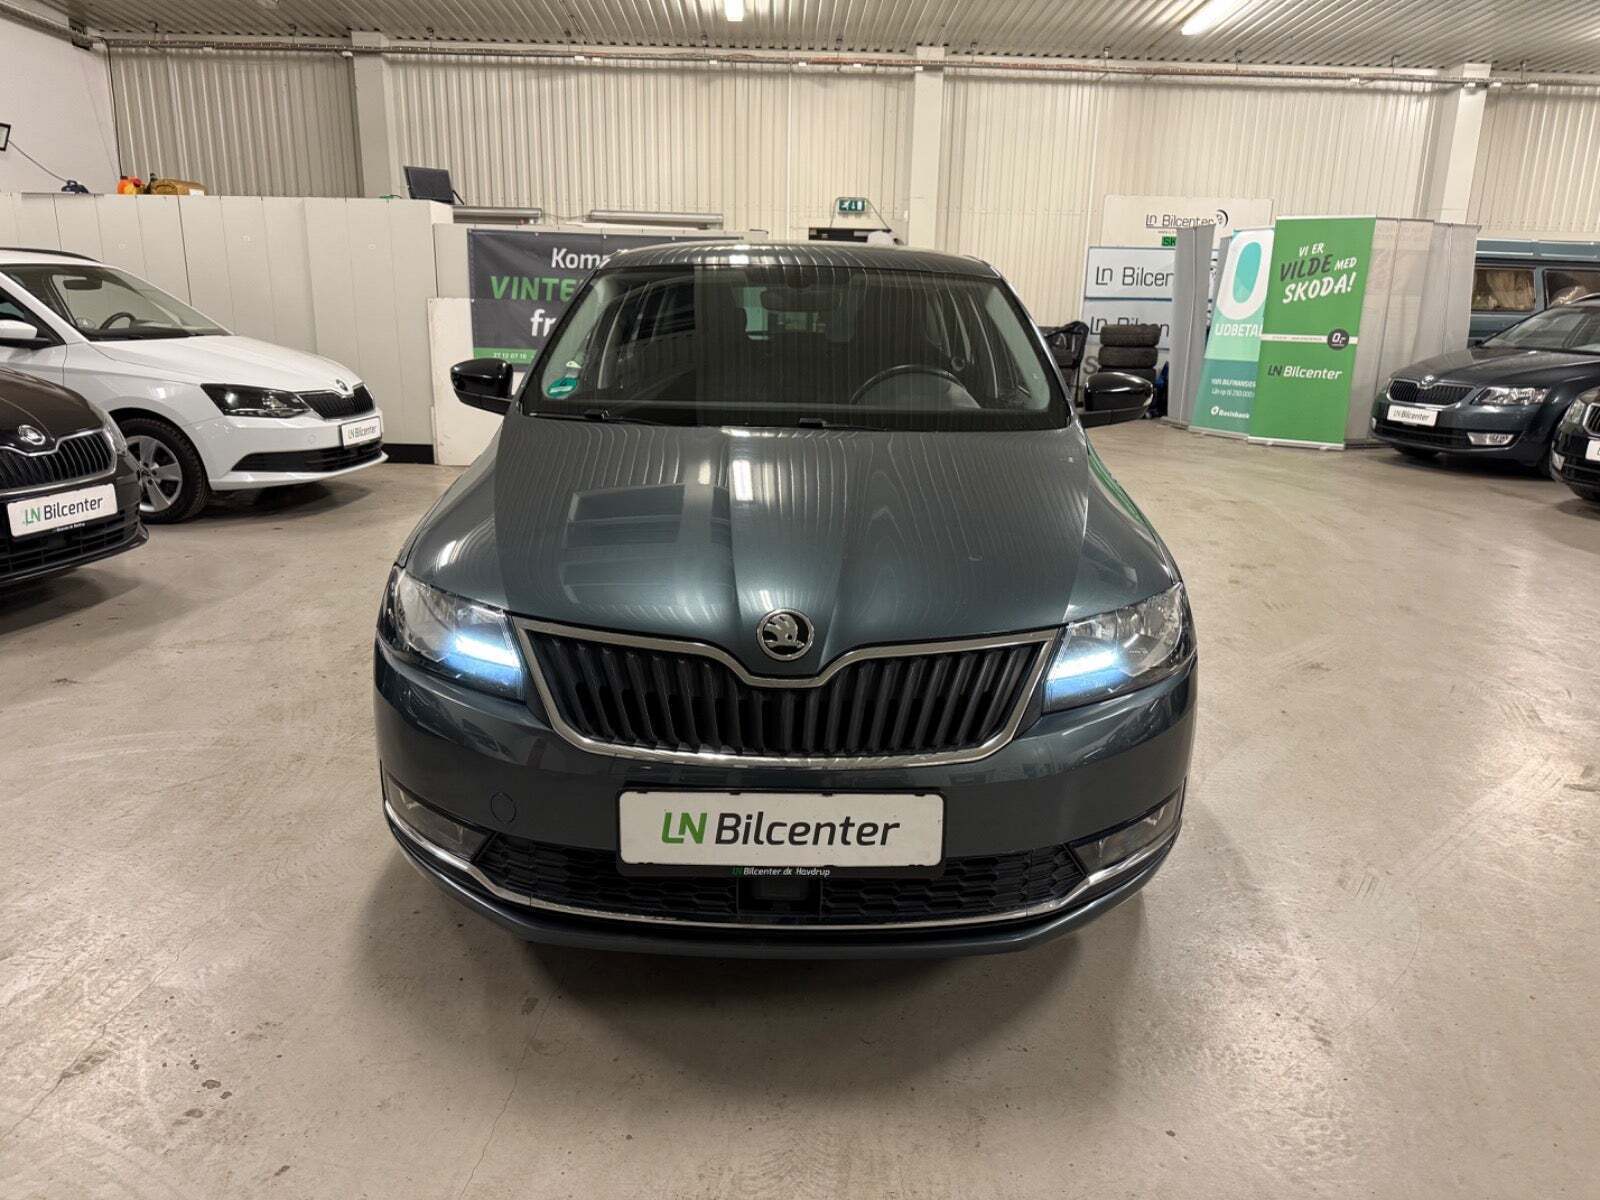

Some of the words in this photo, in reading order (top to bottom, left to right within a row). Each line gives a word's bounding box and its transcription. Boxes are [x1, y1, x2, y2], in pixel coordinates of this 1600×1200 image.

[1164, 236, 1176, 246] SK
[1299, 245, 1309, 257] VI
[1312, 242, 1324, 255] ER
[1122, 266, 1174, 287] Bilcen
[1280, 254, 1333, 282] VILDE
[1334, 257, 1357, 271] MED
[490, 276, 584, 302] VINTE
[1282, 271, 1356, 304] SKODA!
[530, 309, 557, 337] fr
[1283, 365, 1343, 380] Bilcenter
[24, 507, 41, 525] LN
[44, 497, 103, 520] Bilcenter
[661, 811, 708, 845] LN
[715, 811, 900, 846] Bilcenter
